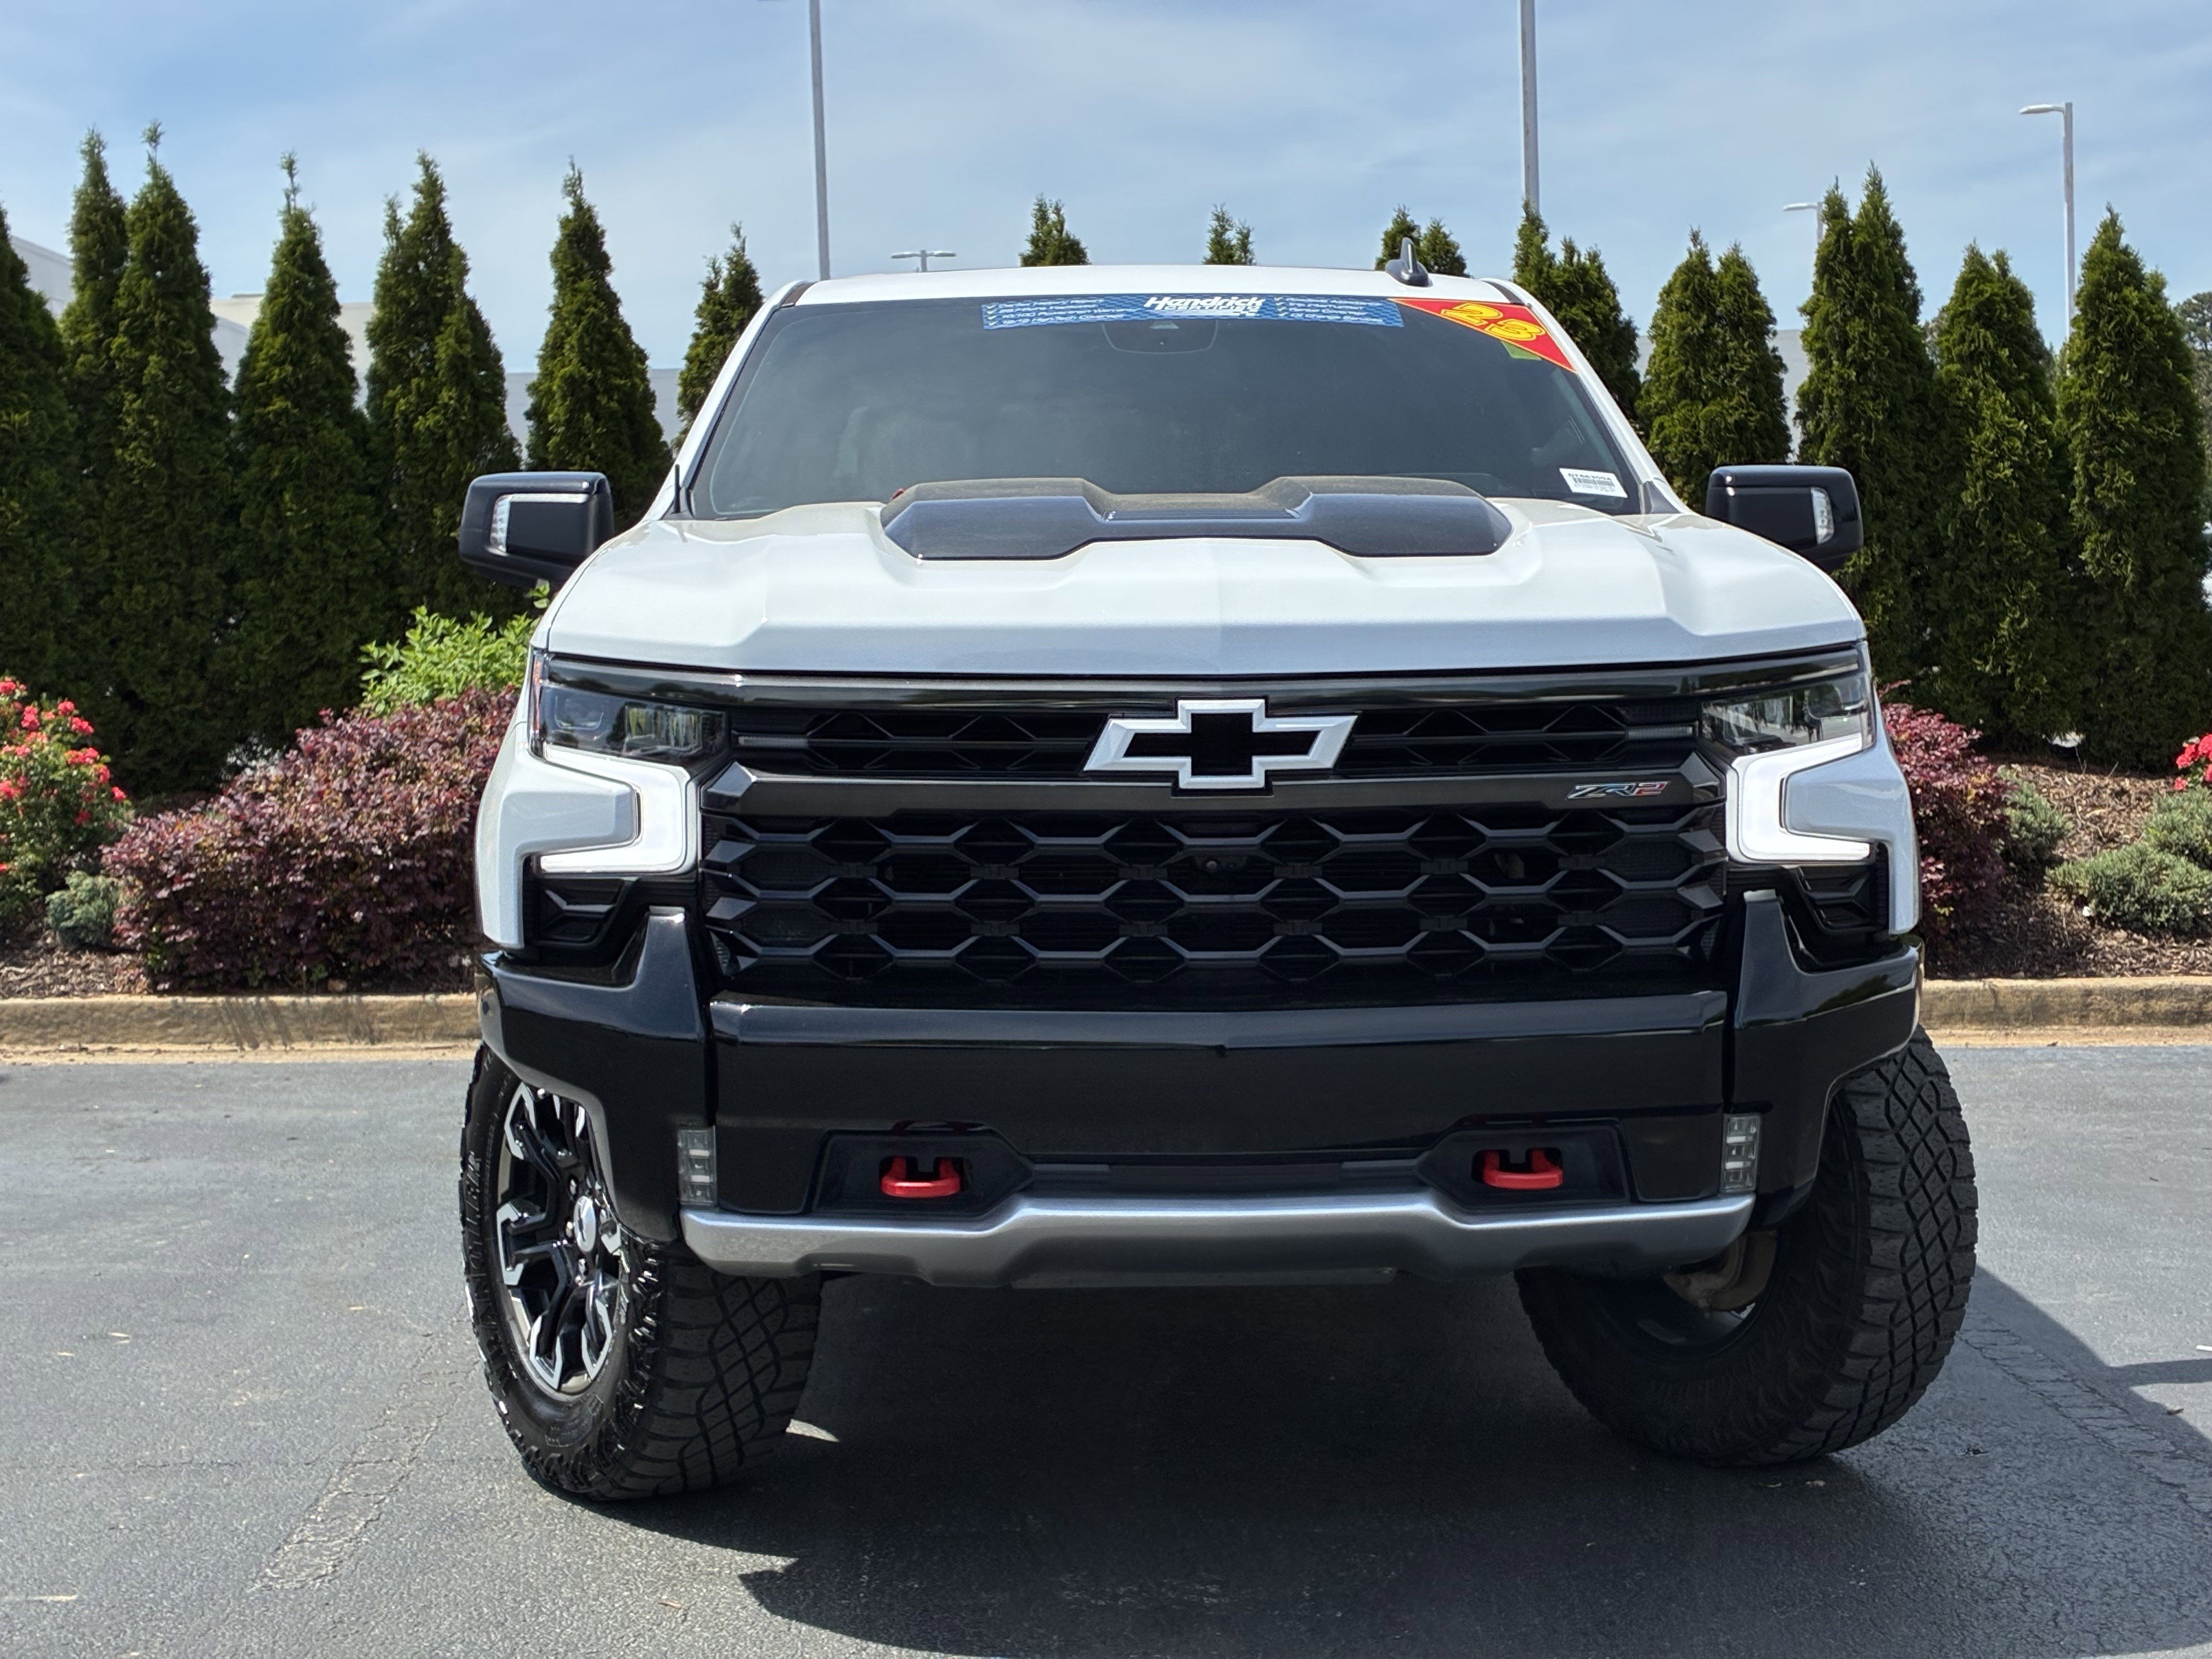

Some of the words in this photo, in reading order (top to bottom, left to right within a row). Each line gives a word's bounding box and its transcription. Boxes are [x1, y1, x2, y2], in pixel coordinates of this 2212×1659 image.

[1143, 296, 1266, 311] Hendrick
[1440, 303, 1546, 341] 23
[1567, 781, 1669, 799] ZR2
